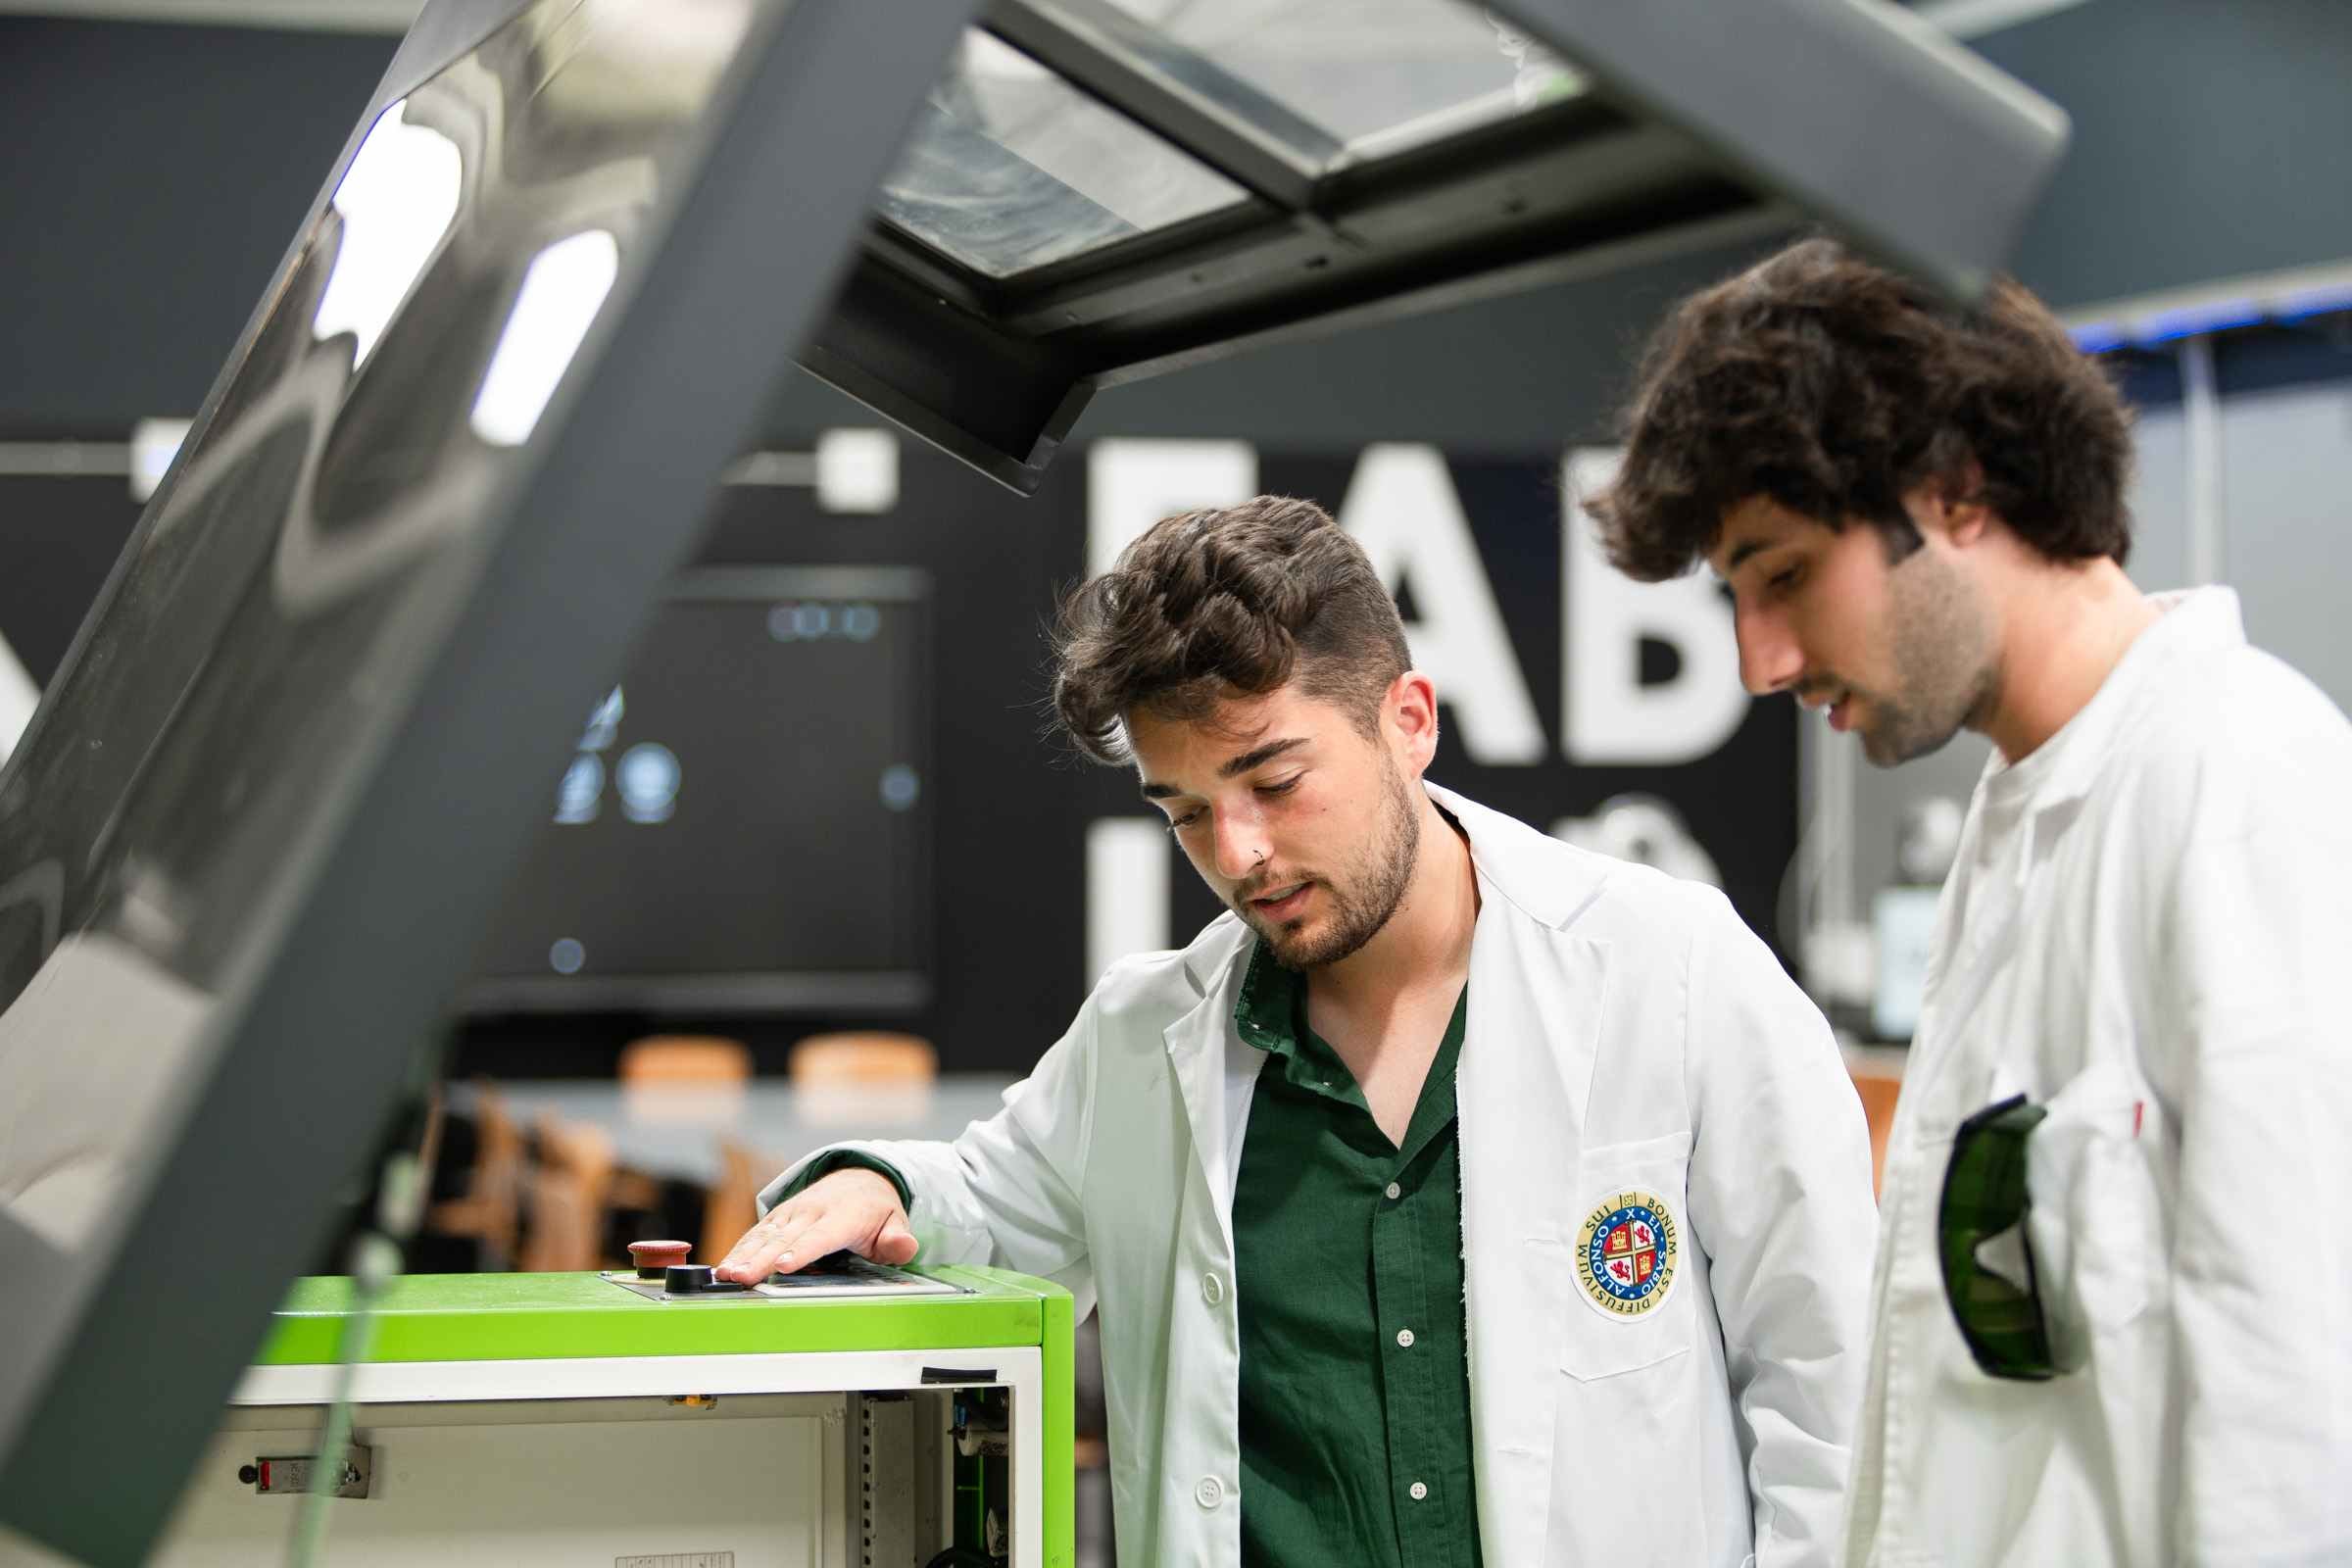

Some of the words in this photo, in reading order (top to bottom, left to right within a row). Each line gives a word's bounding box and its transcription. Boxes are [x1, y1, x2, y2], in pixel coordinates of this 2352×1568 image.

[1587, 1205, 1610, 1231] SUI
[1626, 1208, 1636, 1220] X
[1647, 1198, 1677, 1255] BONUM
[1648, 1214, 1661, 1233] EL
[1577, 1245, 1650, 1312] DIFFUSIVUM
[1592, 1225, 1625, 1296] ALFONSO
[1642, 1250, 1666, 1295] SABIO
[1657, 1268, 1673, 1298] EST
